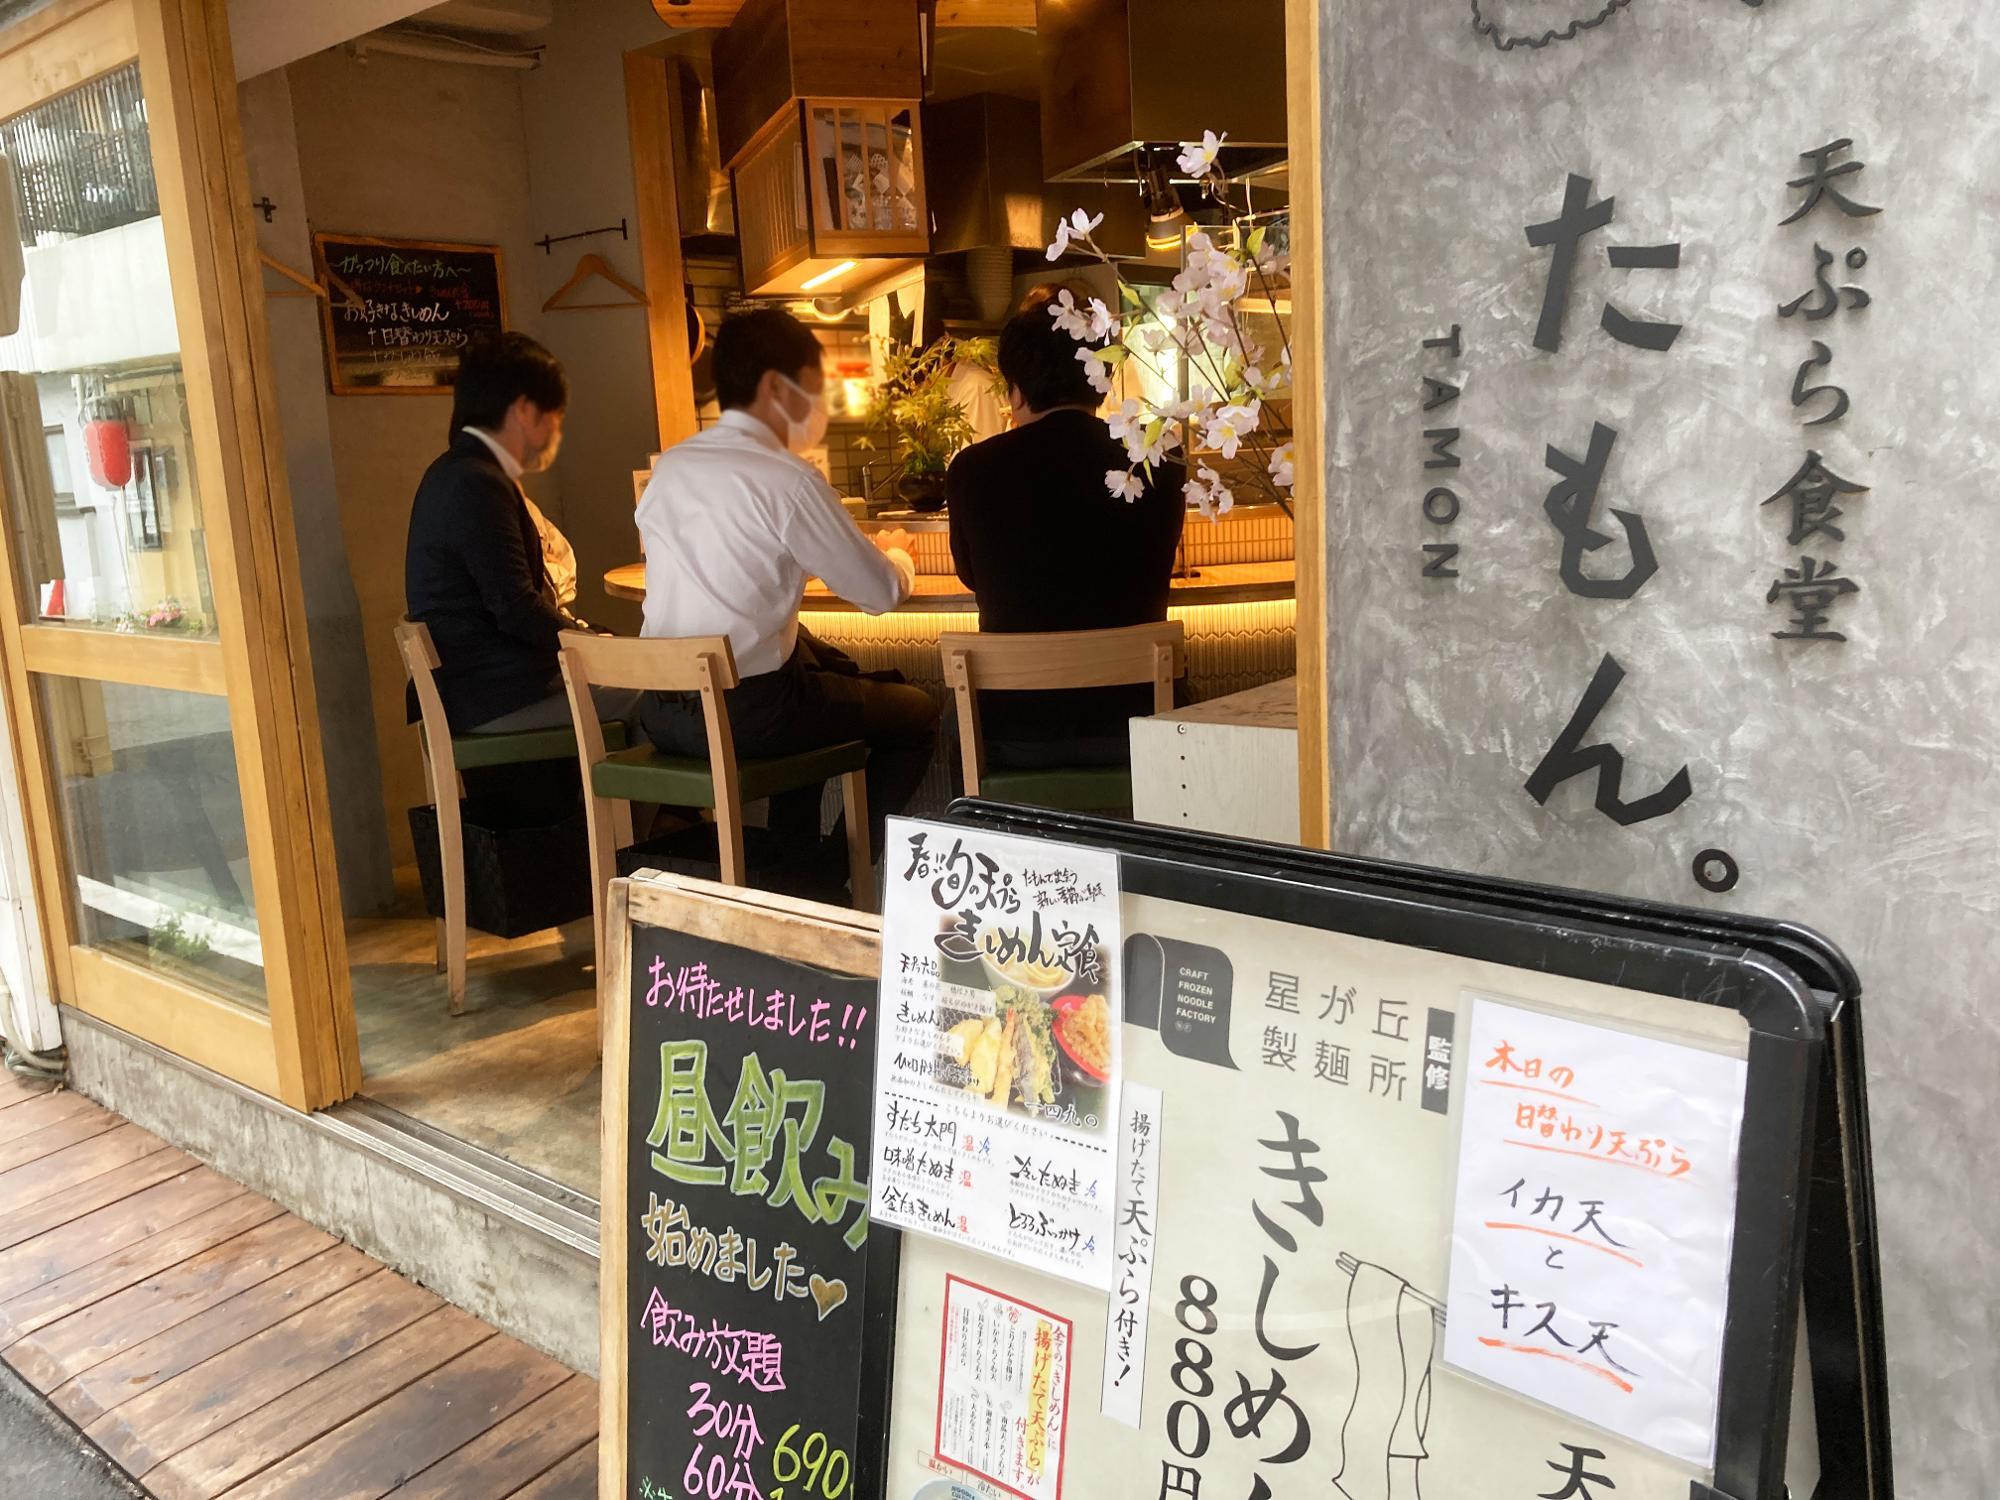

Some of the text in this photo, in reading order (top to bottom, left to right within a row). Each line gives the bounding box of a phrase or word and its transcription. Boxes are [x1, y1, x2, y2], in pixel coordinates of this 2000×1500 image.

[1760, 138, 1883, 643] 天ぷら食堂
[1422, 324, 1461, 579] TAMON
[1523, 172, 1739, 893] たもん。
[934, 908, 1100, 985] きしめん定食
[1179, 967, 1209, 981] CRAFT
[896, 1001, 940, 1027] きしめん
[1176, 1007, 1216, 1024] FACTORY
[1177, 994, 1215, 1010] NOODLE
[1178, 980, 1213, 996] FROZEN
[1265, 971, 1409, 1042] 星が丘
[1262, 1025, 1407, 1101] 製麺所
[1425, 1035, 1452, 1091] 監修
[1485, 1039, 1574, 1088] 本日の
[645, 1040, 870, 1251] 昼飲み
[883, 1146, 955, 1182] 味噌たぬき
[1515, 1103, 1692, 1177] 日替わり天ぷら
[1500, 1178, 1636, 1249] イカ天
[1545, 1246, 1564, 1269] と
[640, 1286, 786, 1392] 飲み放題
[1224, 1110, 1328, 1500] きしめ
[1490, 1284, 1643, 1378] キス天
[1160, 1275, 1218, 1500] 880円
[683, 1443, 764, 1500] 60分
[686, 1382, 765, 1460] 30分
[773, 1424, 849, 1500] 690
